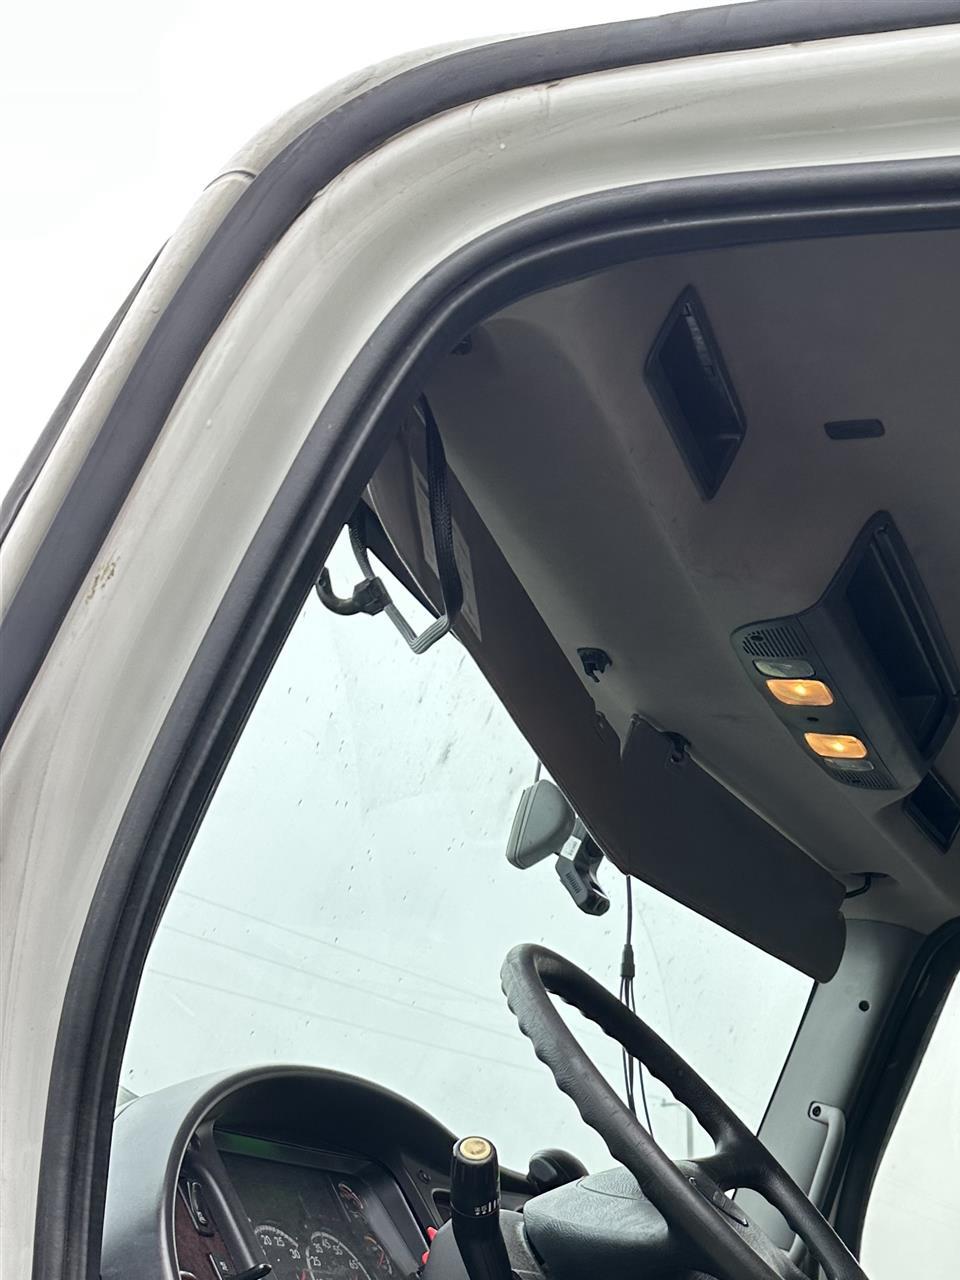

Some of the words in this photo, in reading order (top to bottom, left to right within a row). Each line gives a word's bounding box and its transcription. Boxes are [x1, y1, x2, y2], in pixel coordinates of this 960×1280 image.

[261, 1235, 272, 1246] 20
[274, 1236, 285, 1247] 25
[289, 1248, 301, 1259] 30
[348, 1260, 359, 1270] 65
